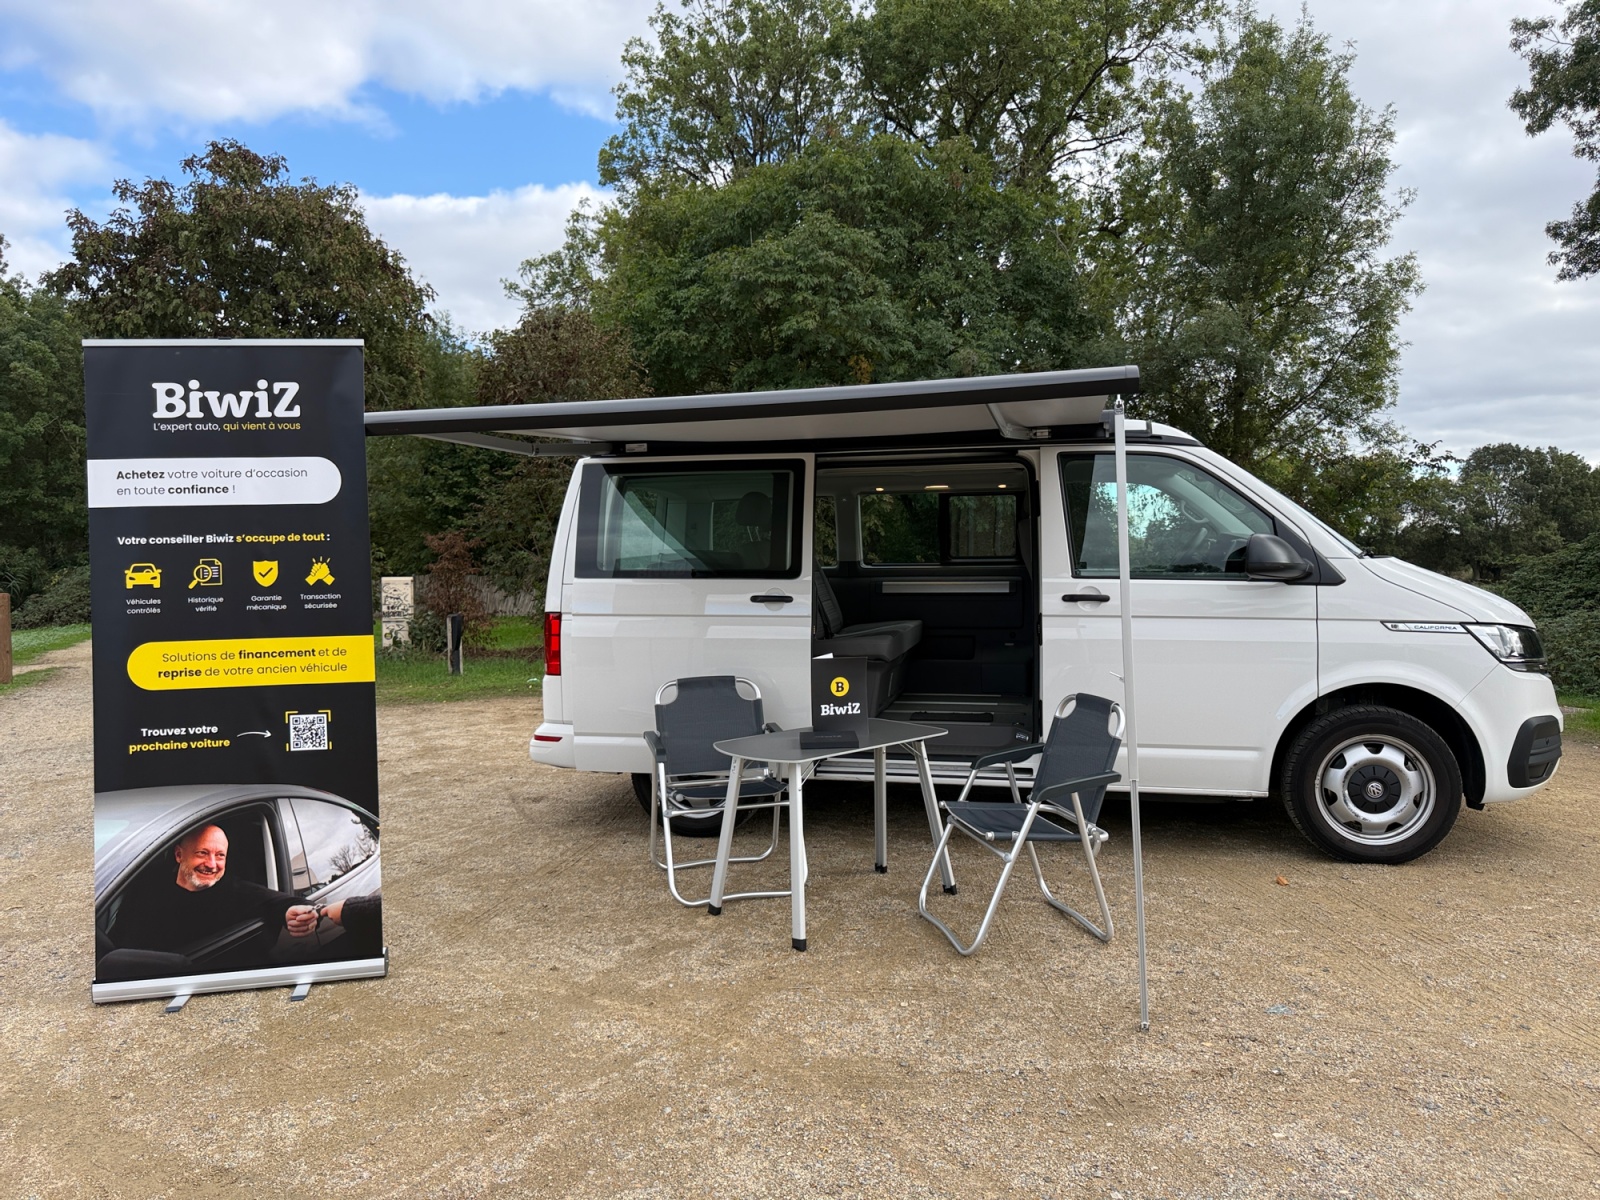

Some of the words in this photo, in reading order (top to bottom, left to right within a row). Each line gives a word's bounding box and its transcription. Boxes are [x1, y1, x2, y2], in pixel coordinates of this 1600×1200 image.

[151, 379, 301, 419] BiwiZ
[194, 423, 221, 432] auto,
[222, 422, 240, 433] qui
[241, 422, 267, 431] vient
[268, 421, 276, 430] à
[277, 422, 301, 430] vous
[116, 470, 165, 480] Achetez
[167, 469, 198, 479] votre
[200, 468, 242, 479] voiture
[116, 487, 131, 496] en
[133, 486, 166, 495] toute
[167, 484, 229, 495] confiance
[232, 484, 236, 494] !
[117, 536, 147, 546] Votre
[148, 534, 204, 545] conseiller
[205, 533, 234, 543] Biwiz
[287, 532, 301, 542] de
[302, 532, 325, 541] tout
[125, 598, 162, 606] Véhicules
[187, 596, 224, 604] Historique
[250, 594, 282, 602] Garantie
[300, 592, 342, 600] Transaction
[126, 606, 161, 615] contrôlés
[195, 604, 217, 612] vérifié
[246, 603, 287, 611] mécanique
[304, 601, 338, 610] sécurisée
[162, 651, 217, 662] Solutions
[220, 650, 236, 660] de
[238, 648, 316, 659] financement
[318, 648, 330, 657] et
[331, 647, 347, 657] de
[157, 668, 202, 681] reprise
[204, 666, 220, 677] de
[222, 666, 254, 676] votre
[256, 664, 297, 675] ancien
[300, 662, 348, 673] véhicule
[835, 682, 845, 692] B
[820, 702, 861, 716] BiwiZ
[141, 727, 187, 737] Trouvez
[188, 725, 219, 734] votre
[128, 741, 188, 754] prochaine
[190, 738, 231, 749] voiture
